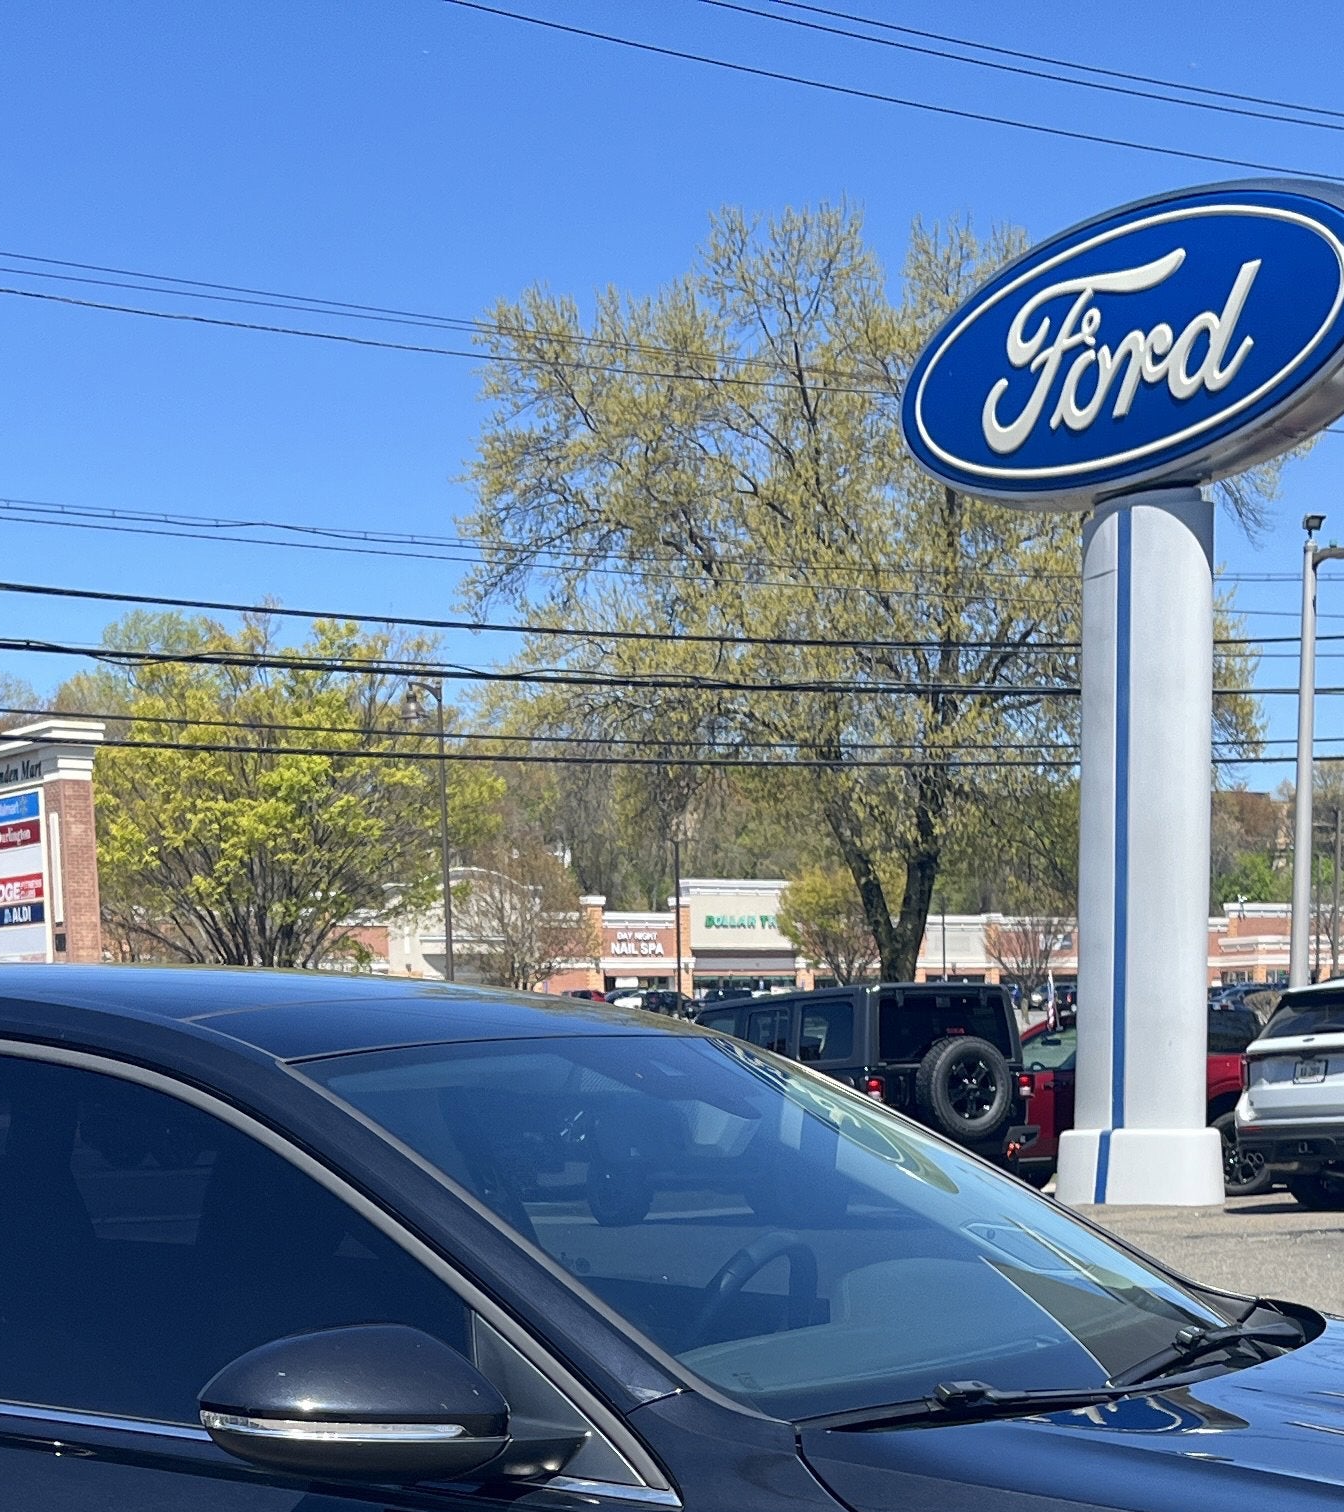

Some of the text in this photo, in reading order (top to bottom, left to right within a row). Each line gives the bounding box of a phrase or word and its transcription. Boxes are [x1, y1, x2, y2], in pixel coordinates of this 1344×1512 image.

[982, 247, 1262, 454] Ford
[21, 759, 42, 779] Mart
[12, 905, 31, 923] ALDI
[704, 915, 756, 929] DOLLAR
[616, 931, 658, 941] DAY NIGHT
[611, 942, 664, 956] NAIL SPA
